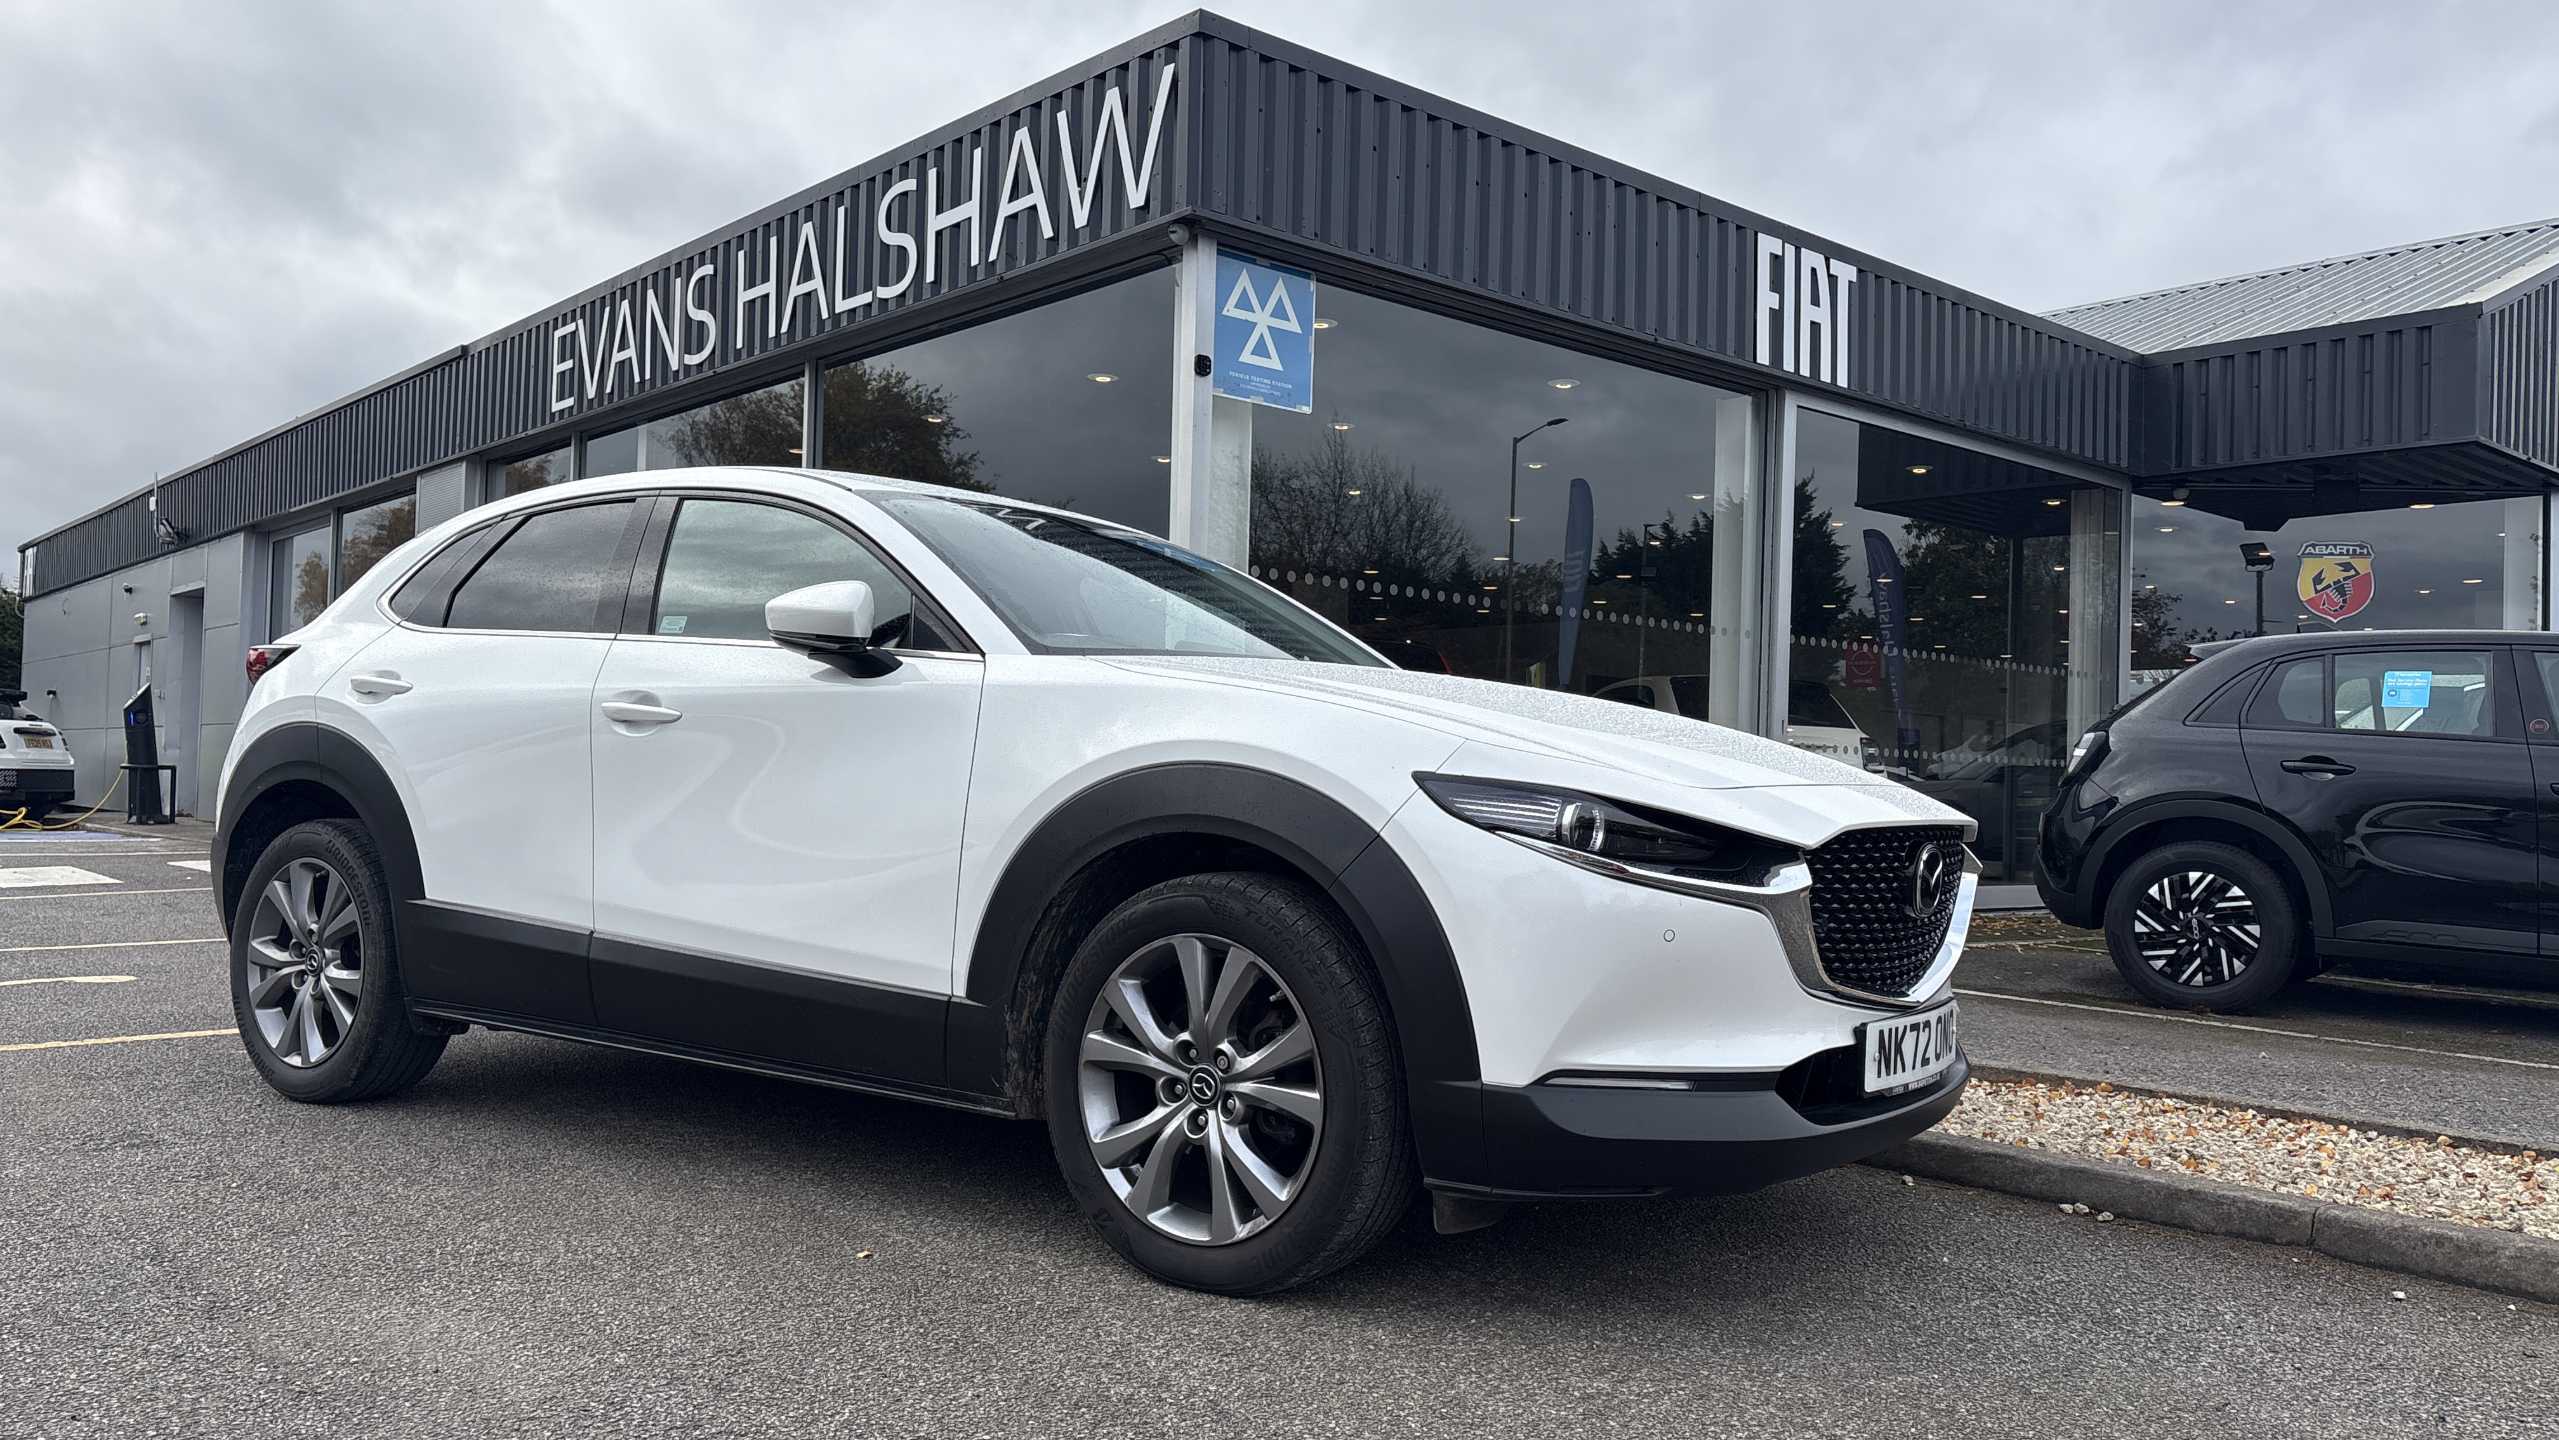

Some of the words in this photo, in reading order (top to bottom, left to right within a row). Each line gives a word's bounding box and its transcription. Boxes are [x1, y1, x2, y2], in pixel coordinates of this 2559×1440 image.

[551, 263, 717, 413] EVANS
[736, 62, 1176, 349] HALSHAW
[1756, 231, 1857, 389] FIAT
[2304, 545, 2368, 555] ABARTH
[1877, 1019, 1932, 1079] NK72
